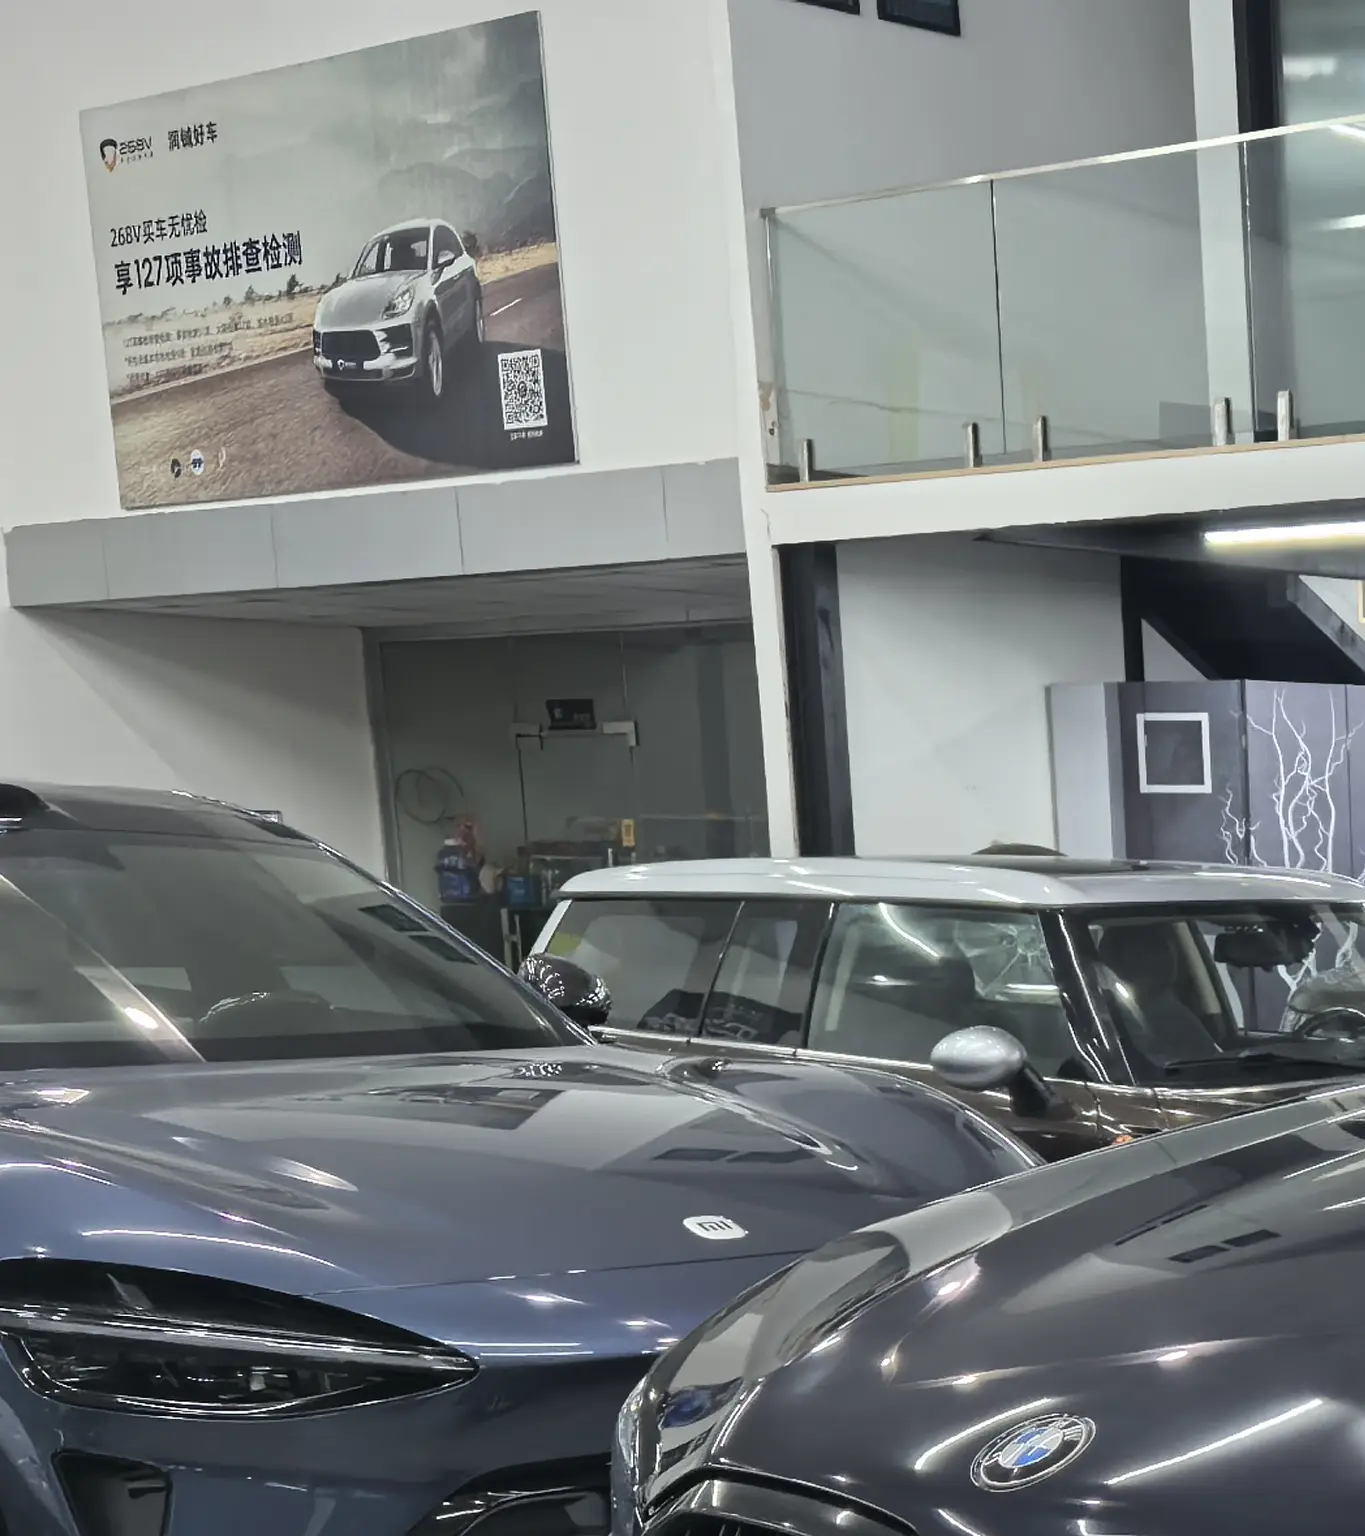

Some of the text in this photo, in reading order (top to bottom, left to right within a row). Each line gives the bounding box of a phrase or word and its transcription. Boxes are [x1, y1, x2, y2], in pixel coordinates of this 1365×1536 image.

[114, 231, 303, 296] 享127项事故排查检测
